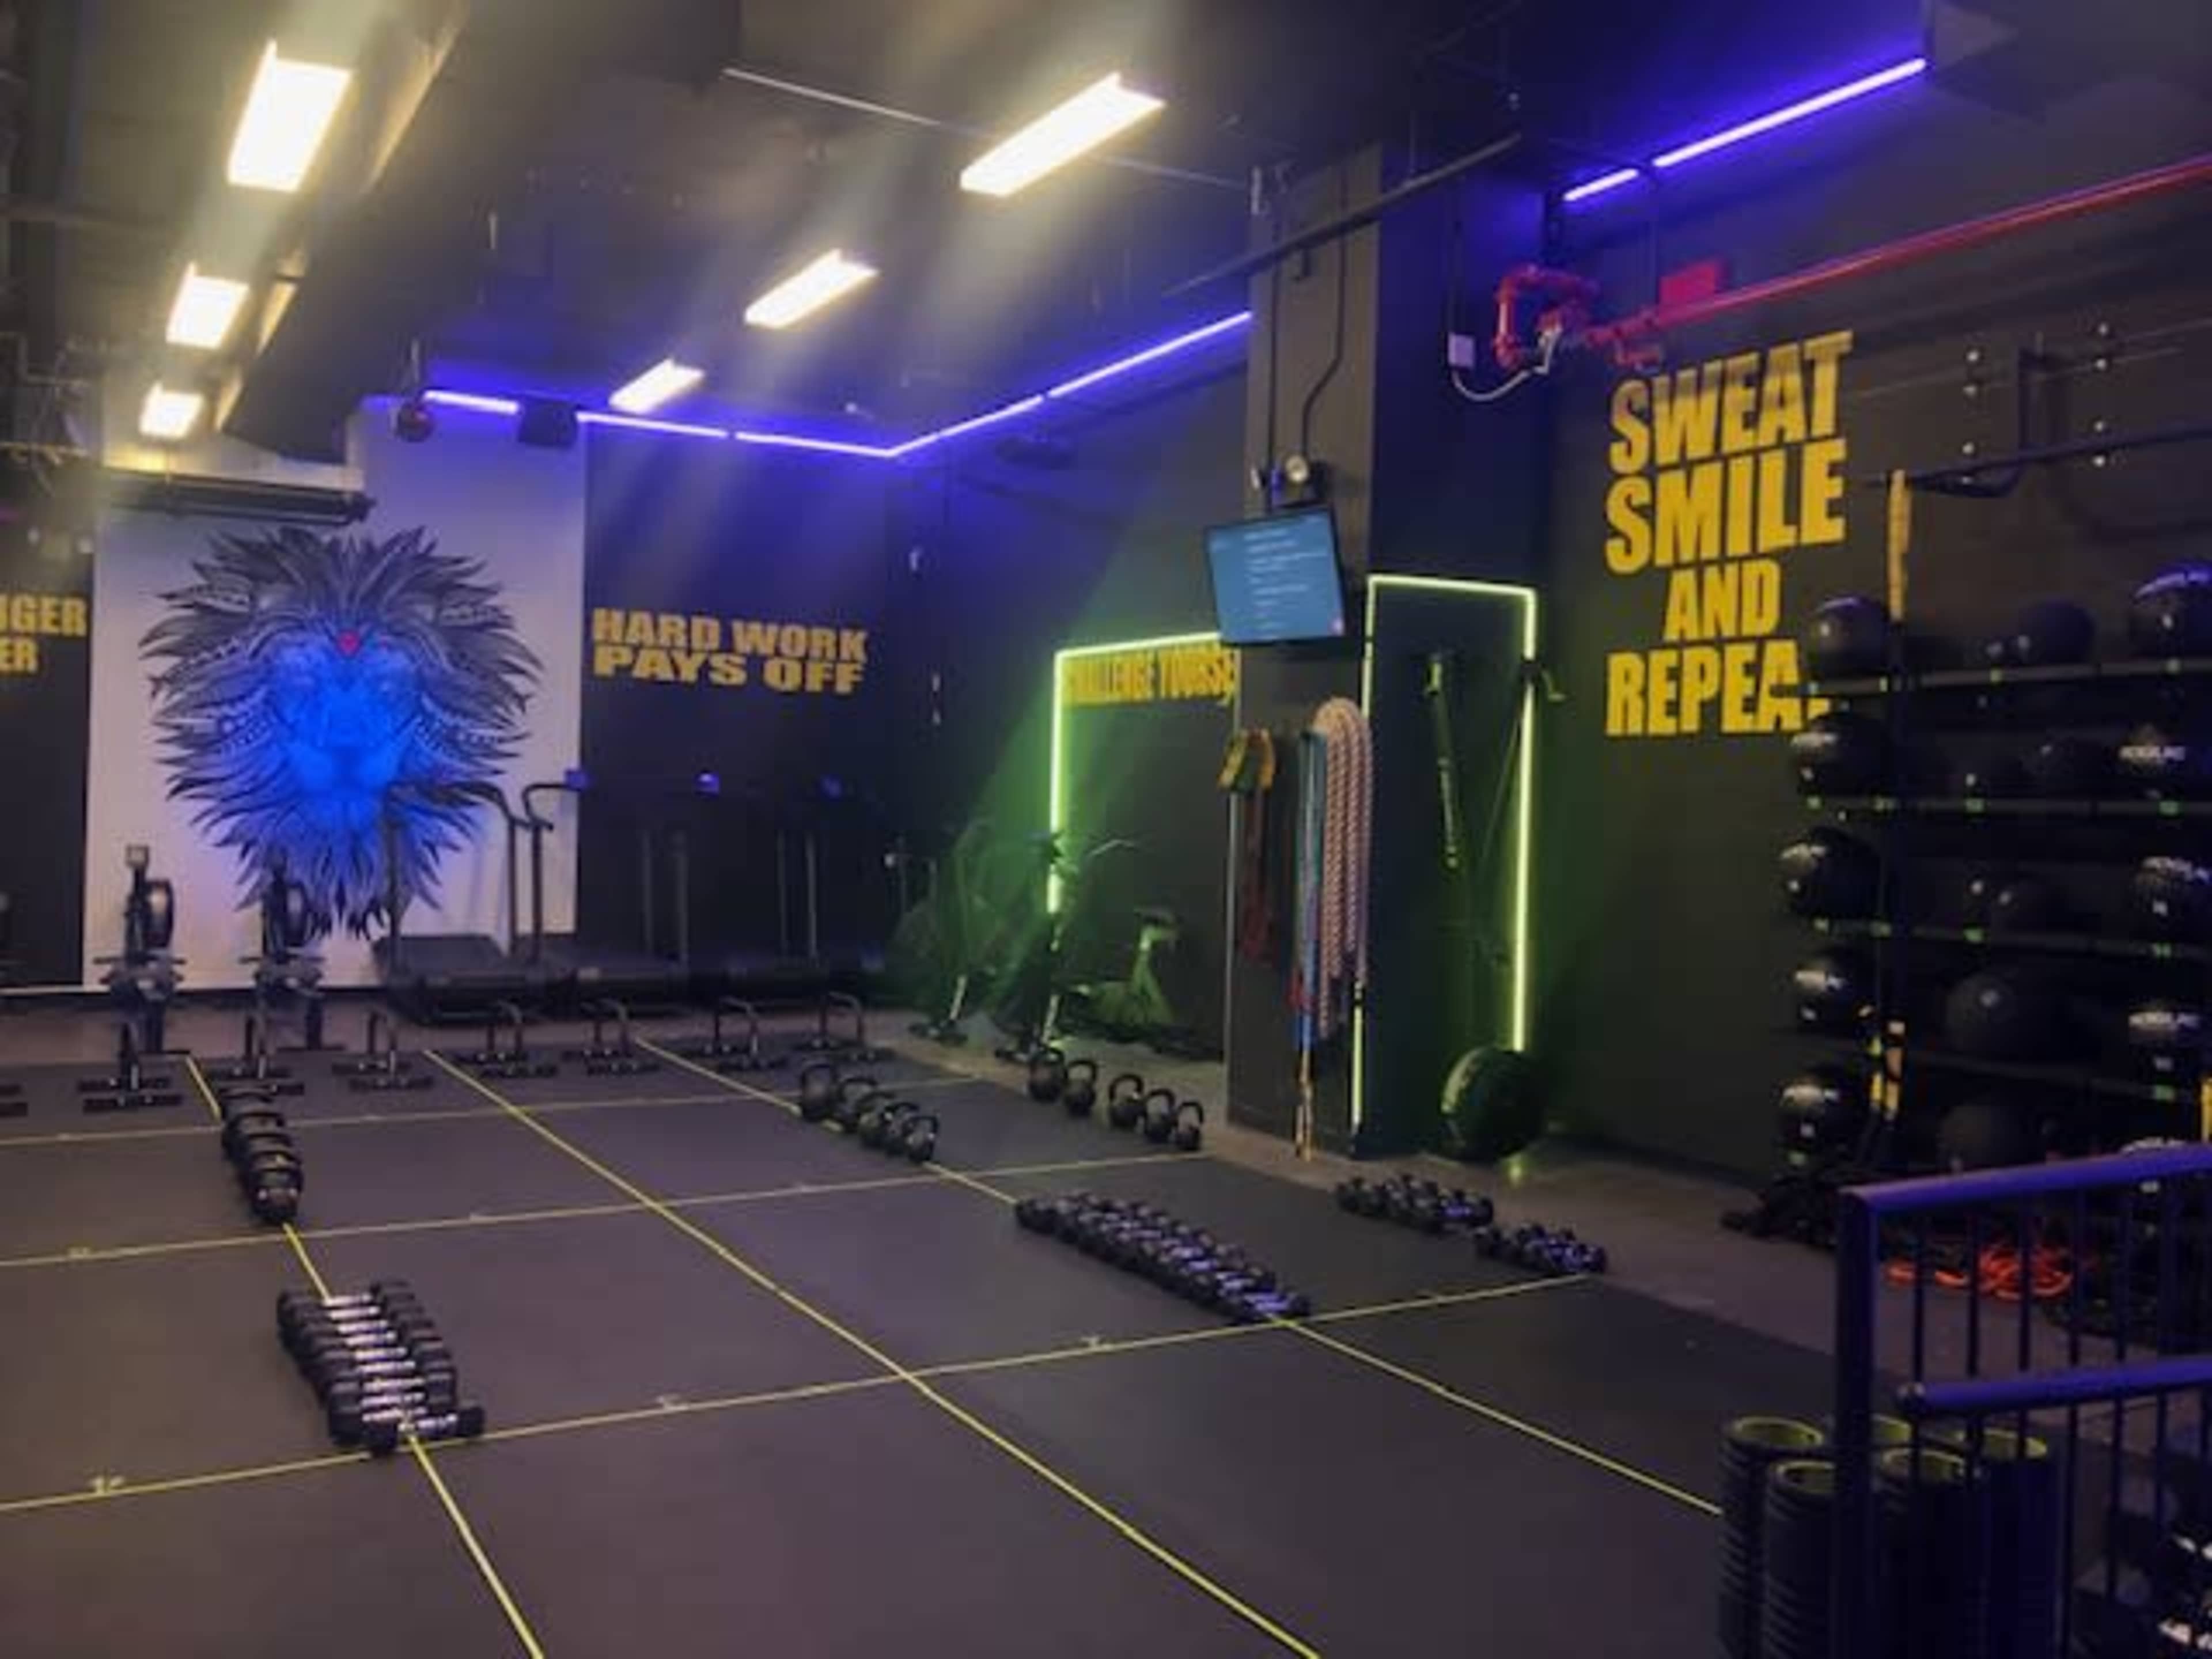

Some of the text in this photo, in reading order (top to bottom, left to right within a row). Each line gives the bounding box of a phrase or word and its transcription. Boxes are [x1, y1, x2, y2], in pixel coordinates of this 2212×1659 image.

[1609, 331, 1854, 474] SWEAT
[1604, 437, 1847, 574] SMILE
[0, 593, 87, 638] GER
[592, 607, 868, 663] HARD WORK
[1664, 557, 1781, 642] AND
[593, 645, 865, 695] PAYS OFF
[1605, 638, 1831, 736] REPEA
